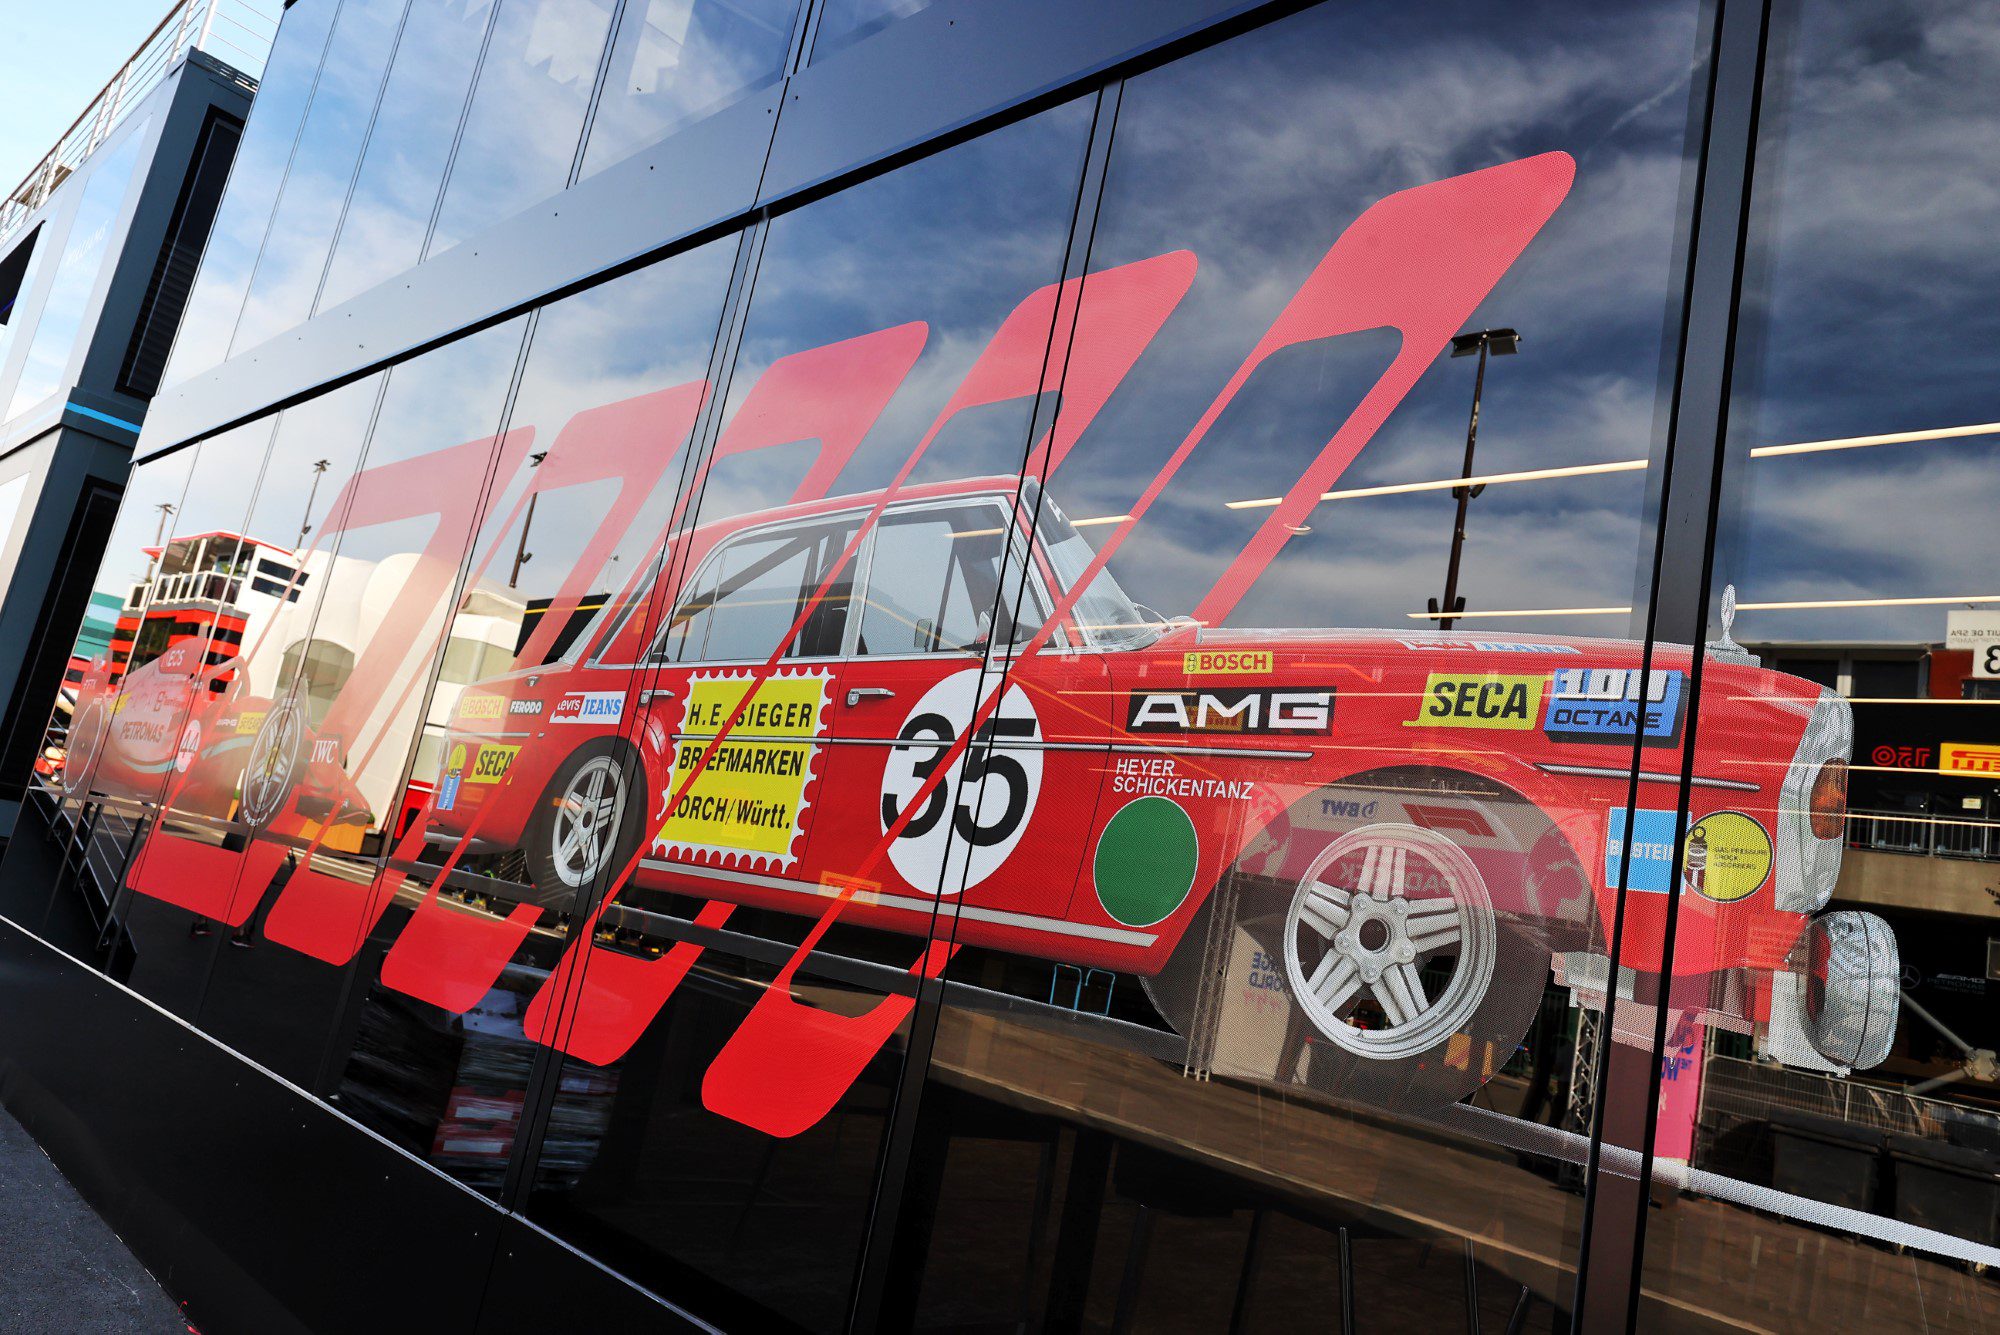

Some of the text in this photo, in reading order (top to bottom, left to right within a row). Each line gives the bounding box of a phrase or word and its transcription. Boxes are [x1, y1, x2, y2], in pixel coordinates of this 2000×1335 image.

[1200, 654, 1267, 671] BOSCH
[468, 700, 501, 718] BOSCH
[509, 700, 542, 714] FERODO
[582, 698, 622, 715] JEANS
[1131, 692, 1330, 730] AMG
[1428, 682, 1528, 719] SECA
[735, 703, 813, 728] SIEGER
[120, 720, 165, 743] PETRONAS
[310, 740, 339, 764] IWC
[1115, 758, 1176, 777] HEYER
[881, 713, 1037, 847] 35
[1112, 776, 1256, 800] SCHICKENTANZ
